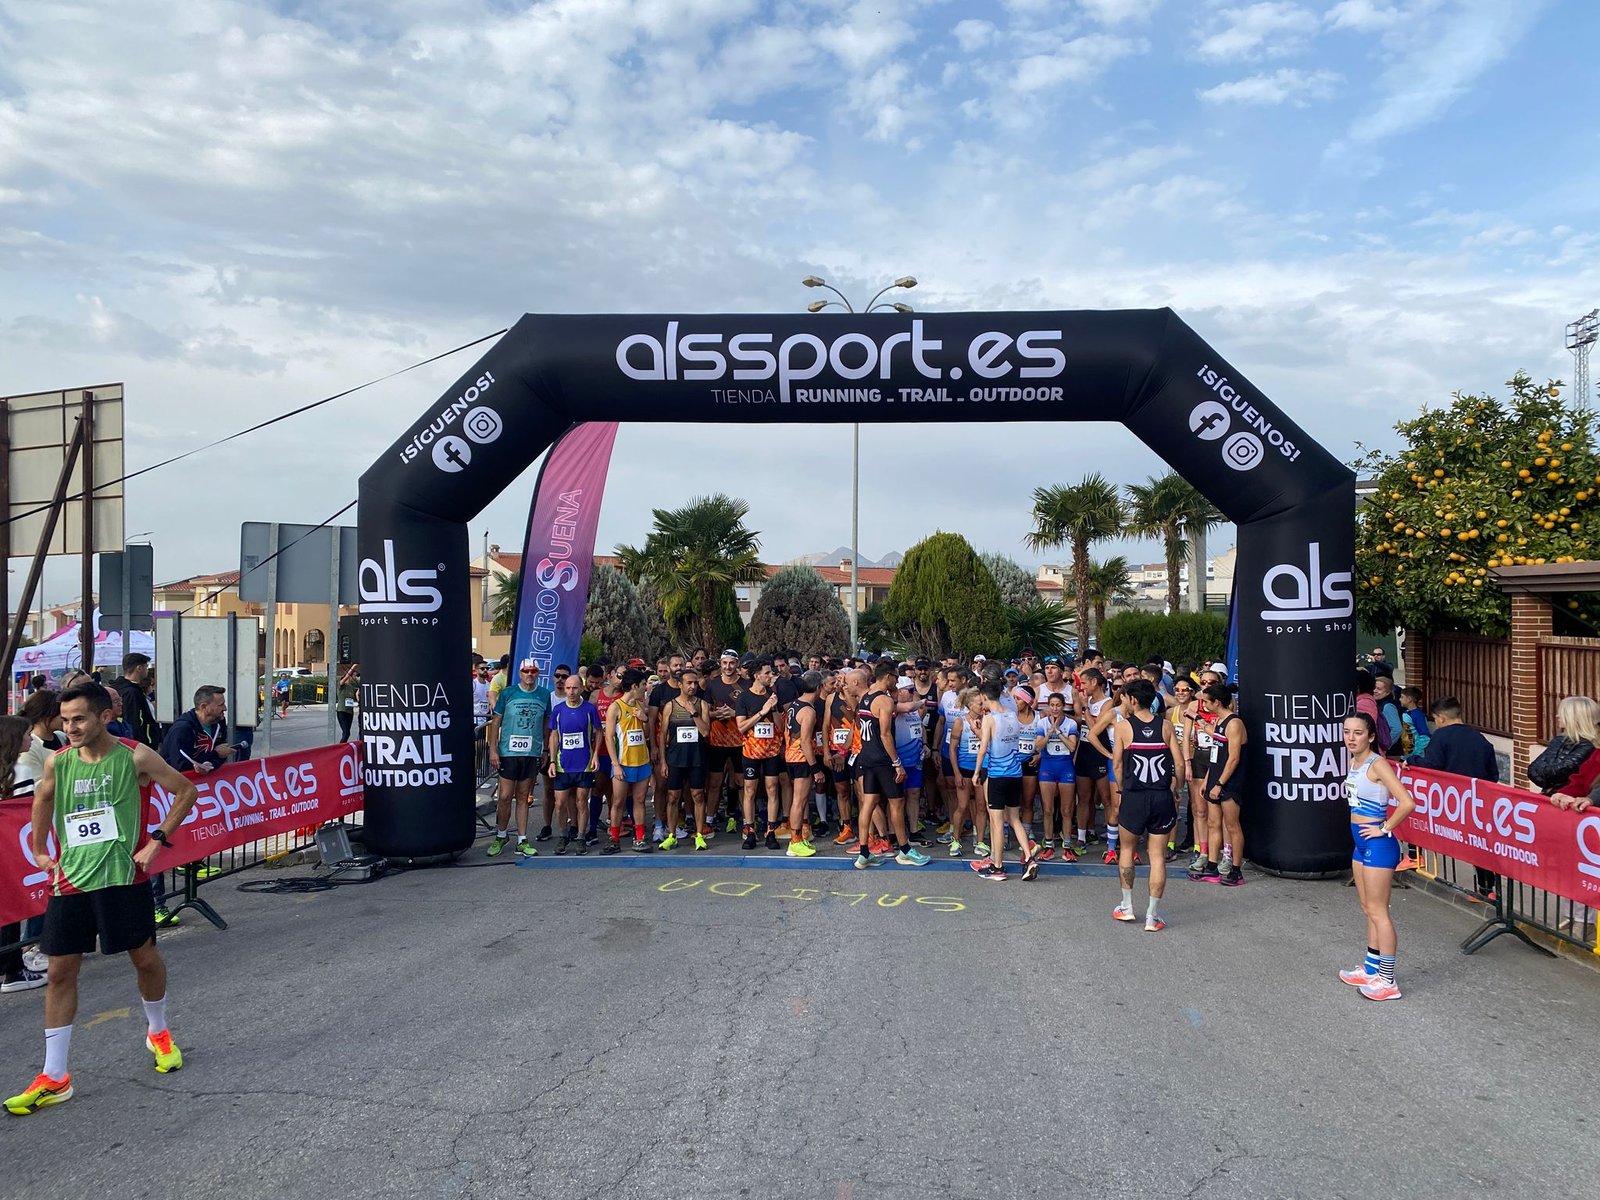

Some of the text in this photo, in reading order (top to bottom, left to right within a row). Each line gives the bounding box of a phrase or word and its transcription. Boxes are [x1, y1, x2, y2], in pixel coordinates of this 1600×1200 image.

[615, 319, 1066, 403] alssport.es
[711, 386, 1064, 404] TIENDA RUNNING TRAIL OUTDOOR
[359, 539, 443, 613] als
[1261, 542, 1354, 620] als
[361, 616, 439, 627] sport shop
[1266, 622, 1353, 636] sport shop
[362, 682, 450, 708] TIENDA
[1264, 691, 1356, 719] TIENDA
[363, 710, 451, 731] RUNNING
[512, 741, 528, 749] 200
[1265, 722, 1344, 744] RUNNI
[363, 734, 453, 765] TRAIL
[365, 767, 453, 787] OUTDOOR
[1267, 781, 1347, 802] OUTDOO
[78, 822, 101, 838] 98
[191, 798, 319, 842] TIENDA RUNNING TRAIL OUTDOOR
[1408, 816, 1539, 867] TIENDA RUNNING TRAIL OUTDOOR
[657, 878, 966, 912] SALIDA
